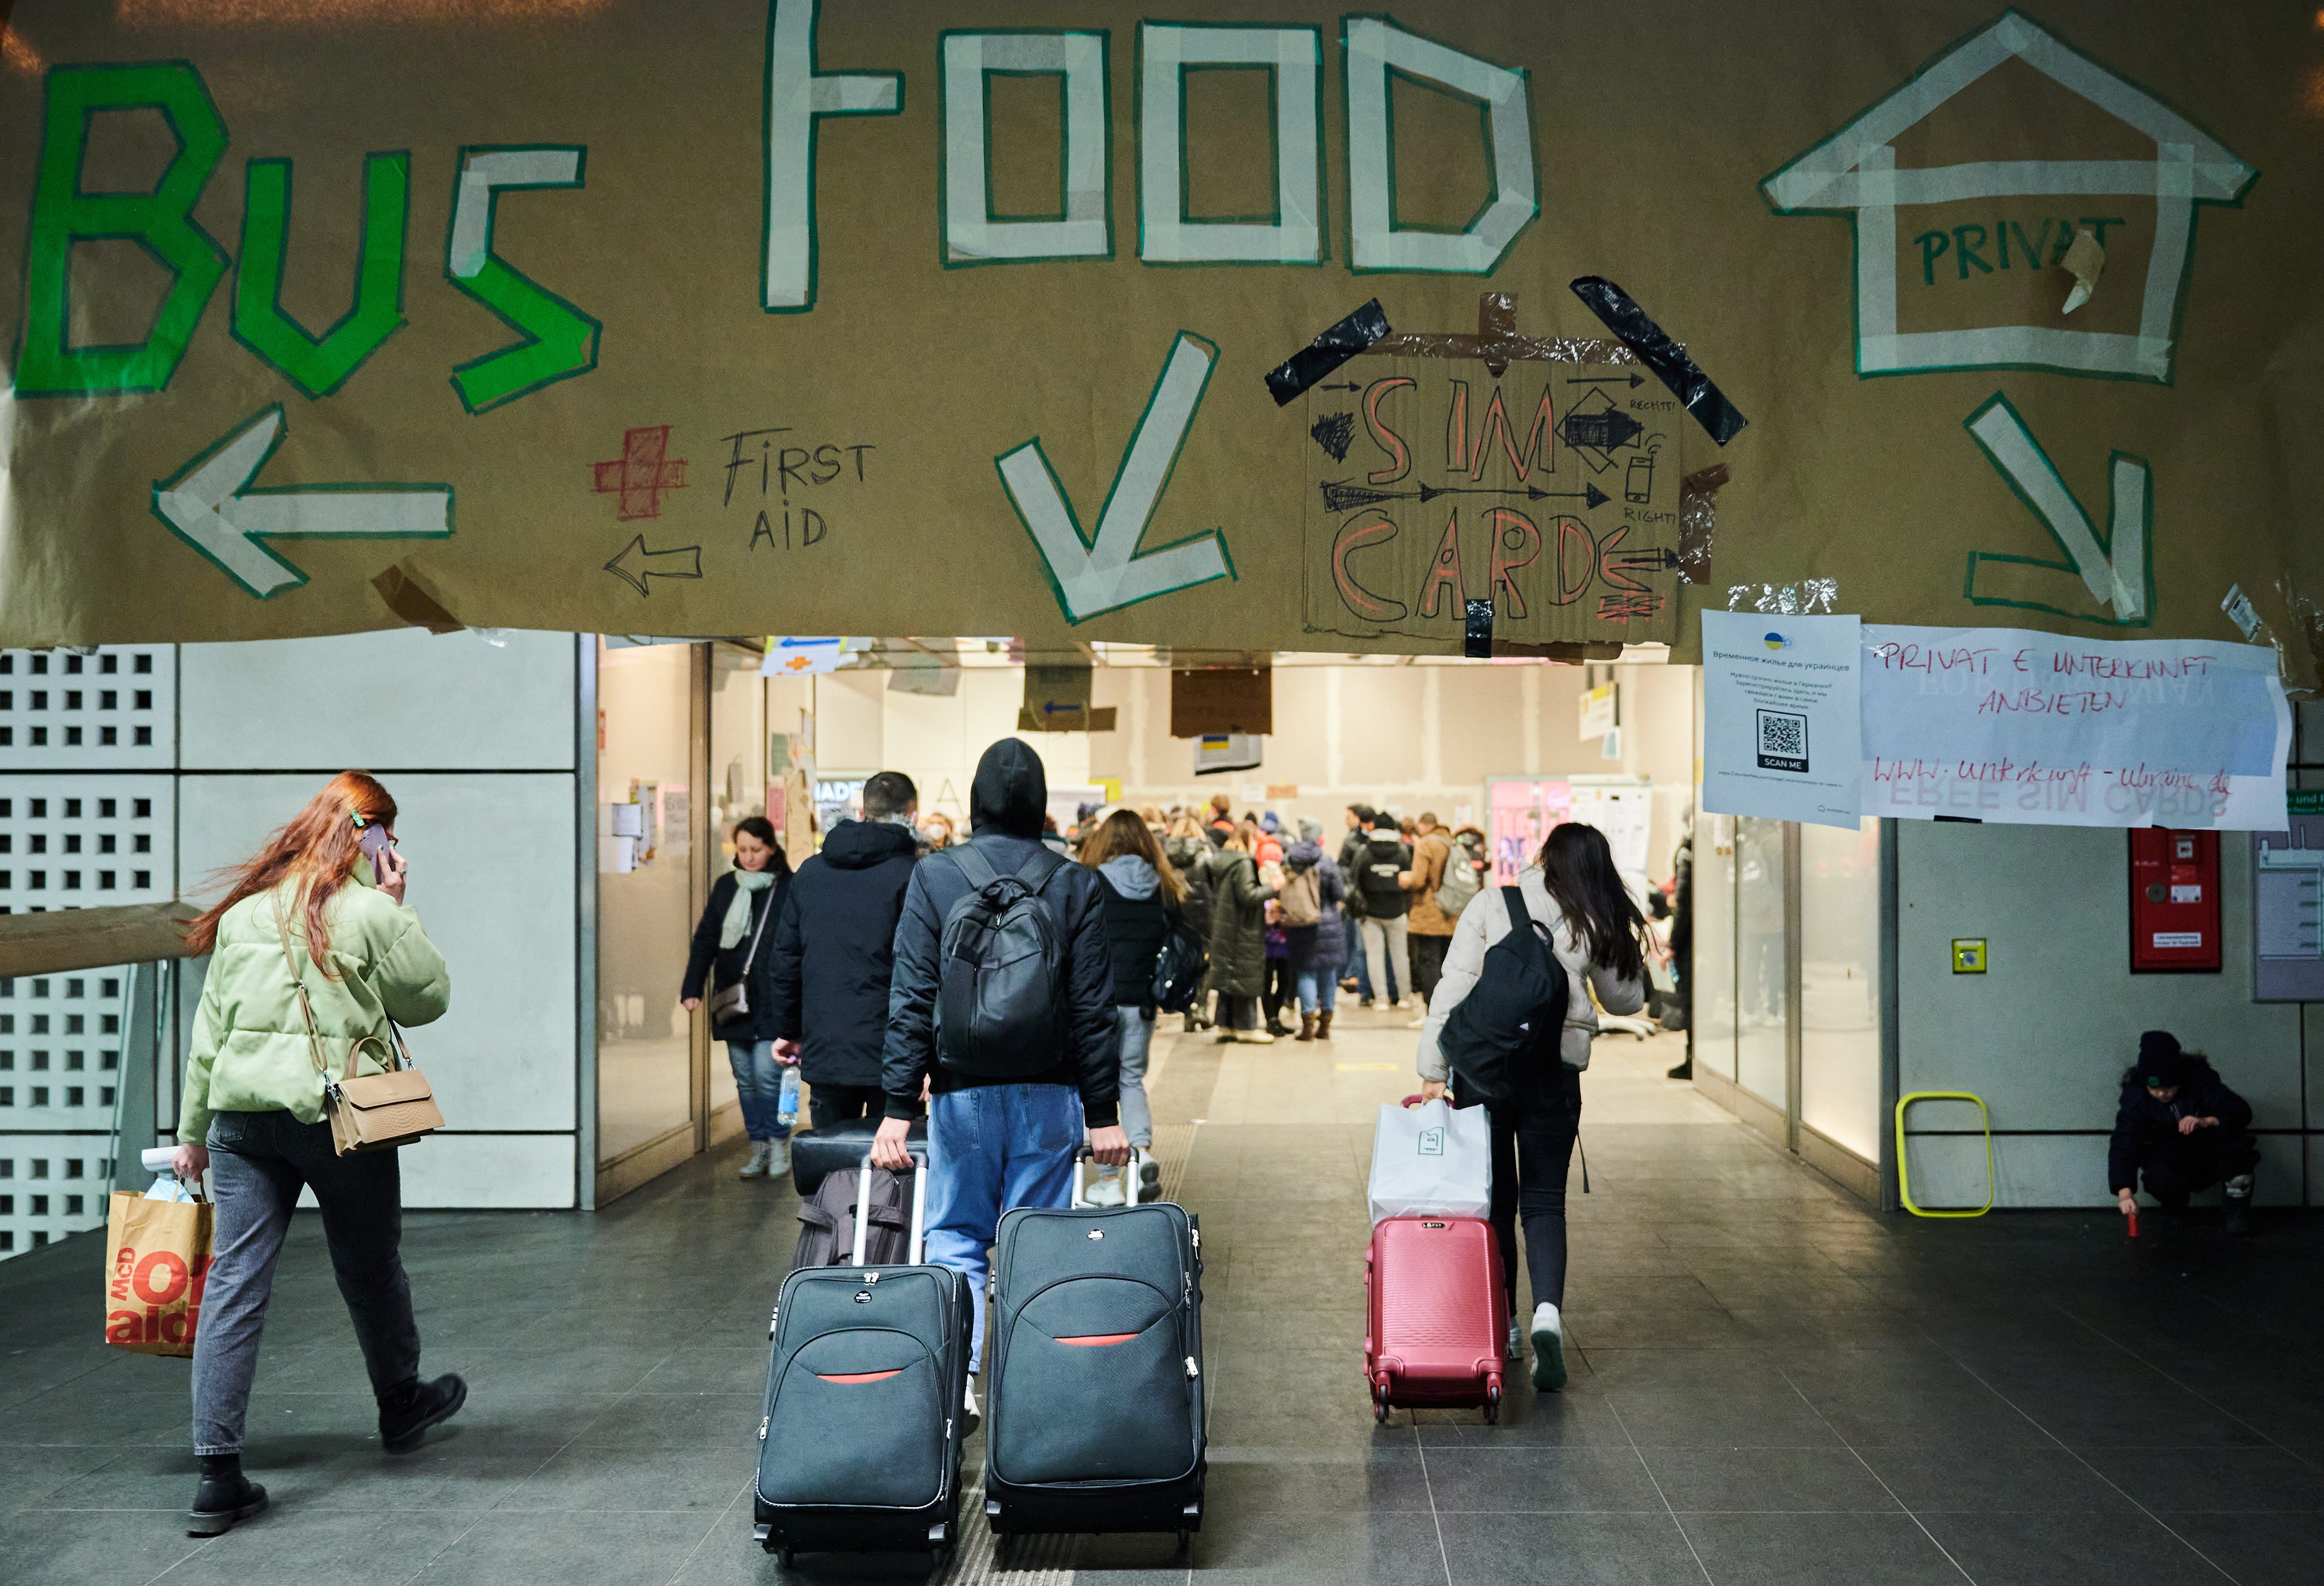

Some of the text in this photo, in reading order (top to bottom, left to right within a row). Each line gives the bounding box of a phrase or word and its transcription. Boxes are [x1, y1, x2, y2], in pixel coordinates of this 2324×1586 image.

[758, 0, 1541, 315] FOOD
[1362, 375, 1555, 484] SIM
[1713, 650, 1850, 672] Временное жилье для украинцев
[1874, 642, 1999, 674] PRIVAT
[1978, 687, 2128, 715] ANBIETEN
[1764, 758, 1802, 769] SCAN ME
